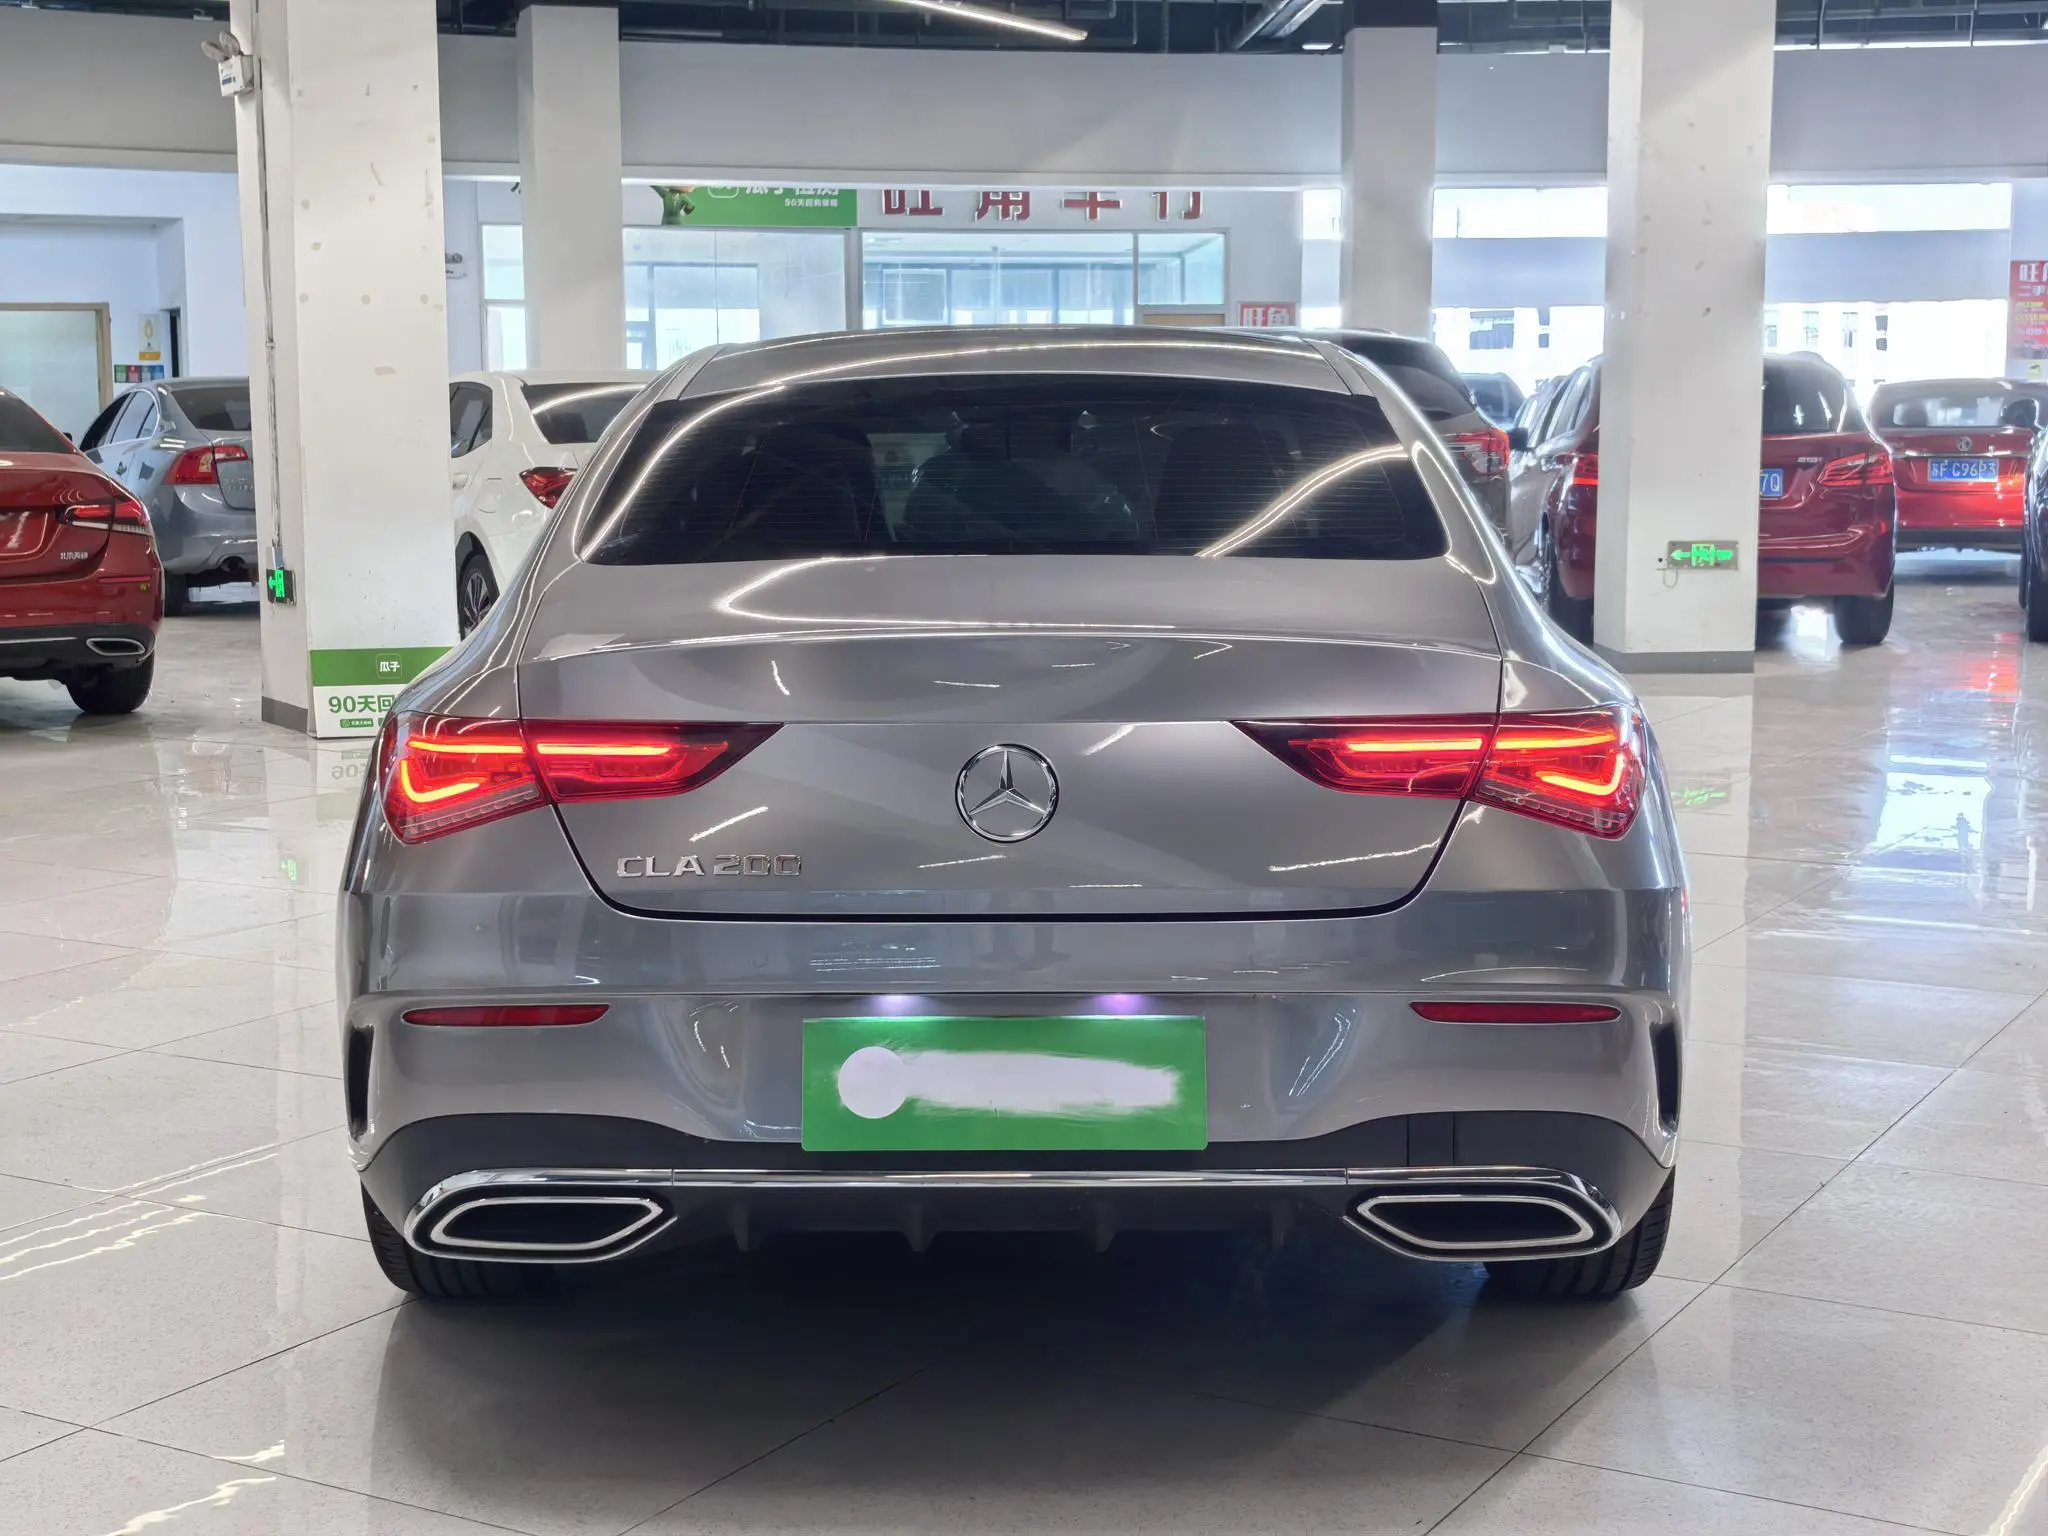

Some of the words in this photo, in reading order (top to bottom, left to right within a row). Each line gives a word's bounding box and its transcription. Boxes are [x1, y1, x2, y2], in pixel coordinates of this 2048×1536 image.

[379, 661, 400, 673] 瓜子
[616, 854, 705, 877] CLA
[713, 854, 802, 877] 200
